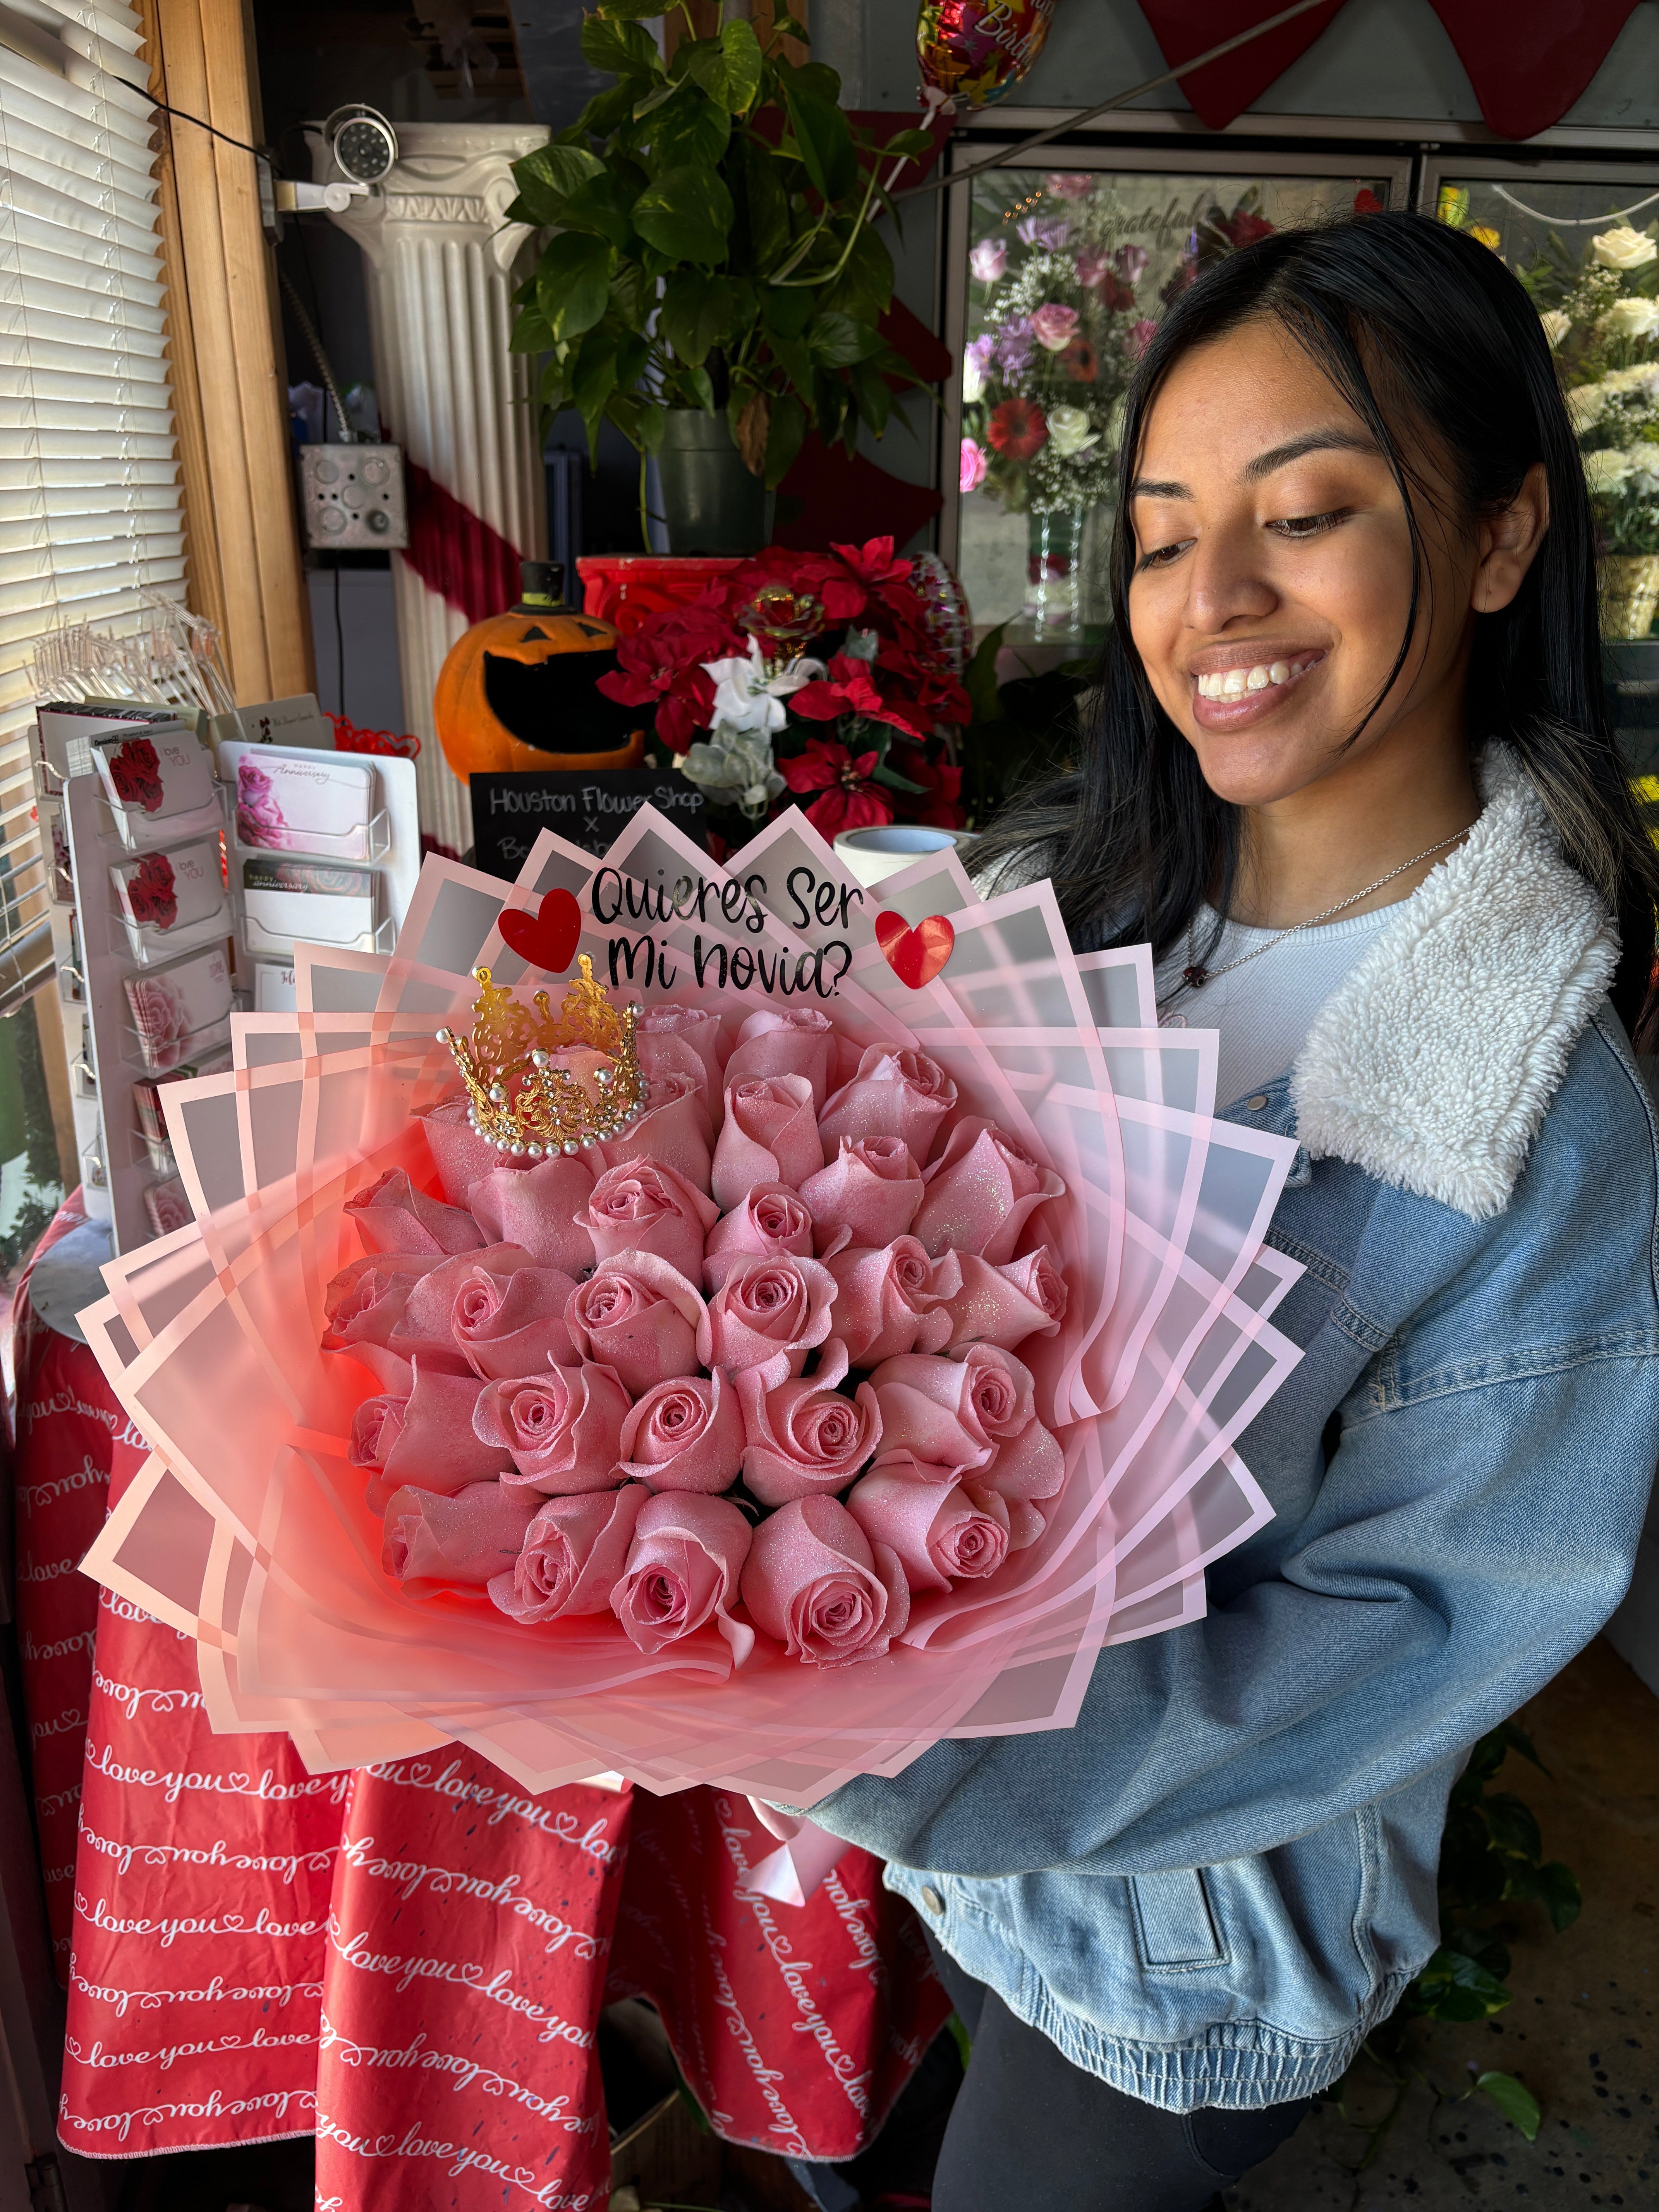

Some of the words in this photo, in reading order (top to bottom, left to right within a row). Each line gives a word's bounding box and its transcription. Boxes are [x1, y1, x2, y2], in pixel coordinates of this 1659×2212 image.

[489, 787, 576, 814] Houston
[654, 786, 704, 814] Shop
[592, 867, 768, 933] Quieres
